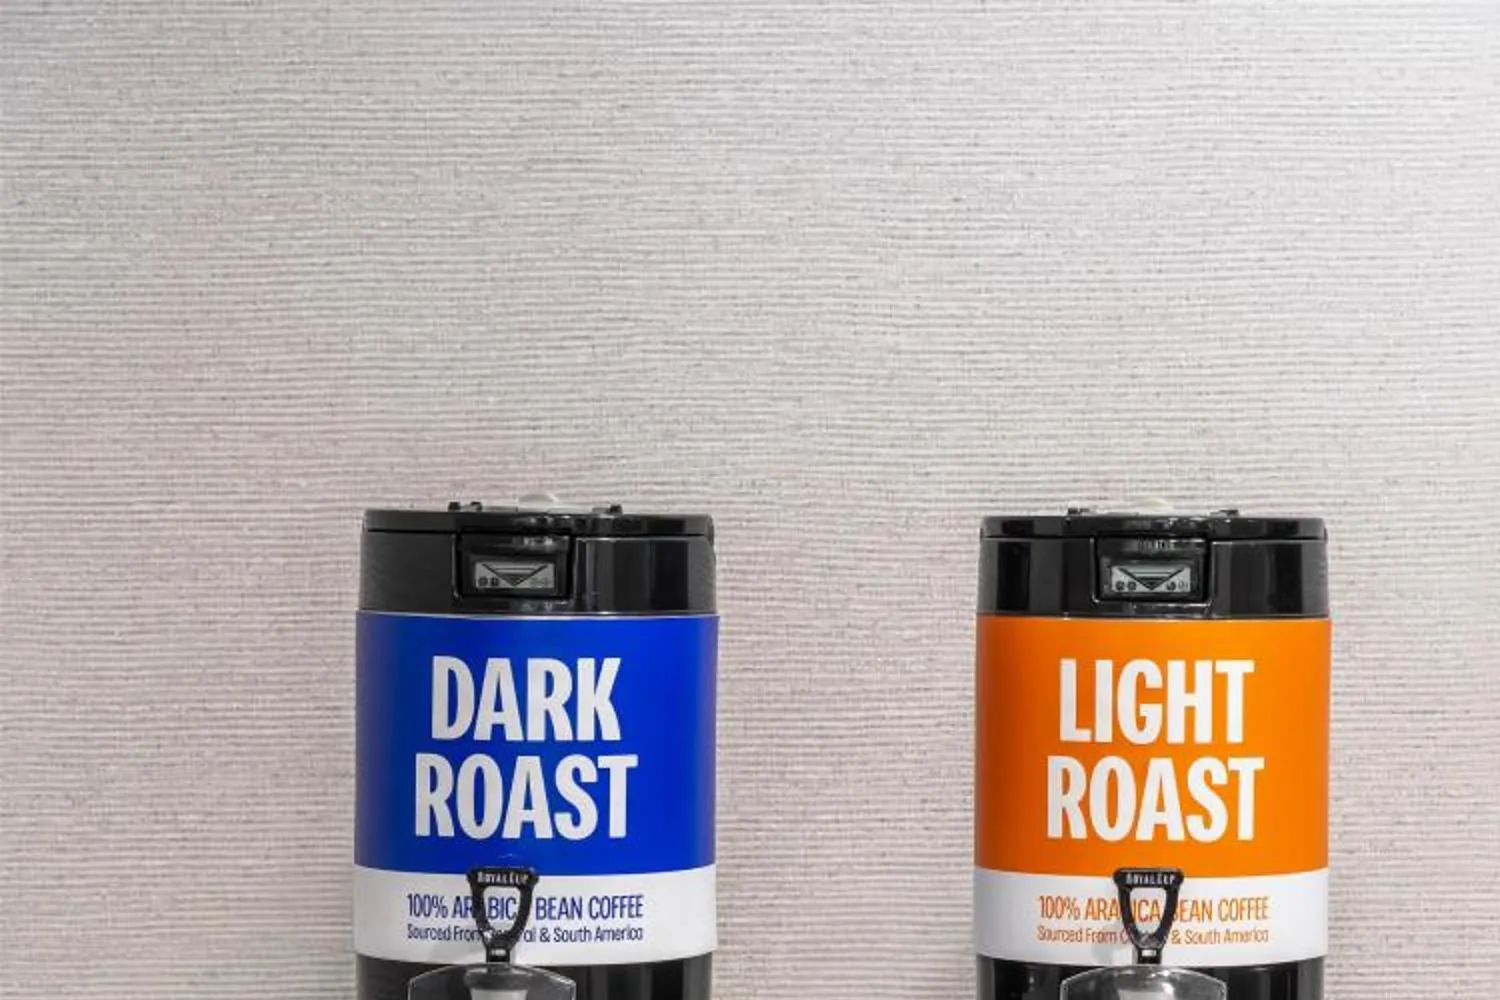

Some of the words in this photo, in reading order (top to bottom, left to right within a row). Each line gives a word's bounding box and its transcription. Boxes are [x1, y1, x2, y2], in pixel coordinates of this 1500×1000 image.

[432, 656, 620, 741] DARK
[1060, 658, 1255, 744] LIGHT
[415, 753, 638, 840] ROAST
[1047, 755, 1265, 842] ROAST
[407, 893, 448, 918] 100%
[453, 895, 522, 920] ARBIC
[536, 895, 582, 920] BEAN
[588, 893, 644, 919] COFFEE
[407, 923, 451, 941] Sourced
[540, 926, 550, 943] &
[553, 924, 592, 943] South
[595, 925, 643, 942] America
[1037, 924, 1083, 943] Sourced
[1085, 927, 1117, 944] From
[1171, 929, 1181, 945] &
[1184, 927, 1221, 945] South
[1223, 927, 1269, 943] America
[1039, 895, 1080, 920] 100%
[1085, 896, 1161, 923] ARAICA
[1174, 896, 1213, 922] EAN
[1218, 896, 1269, 921] COFFEE
